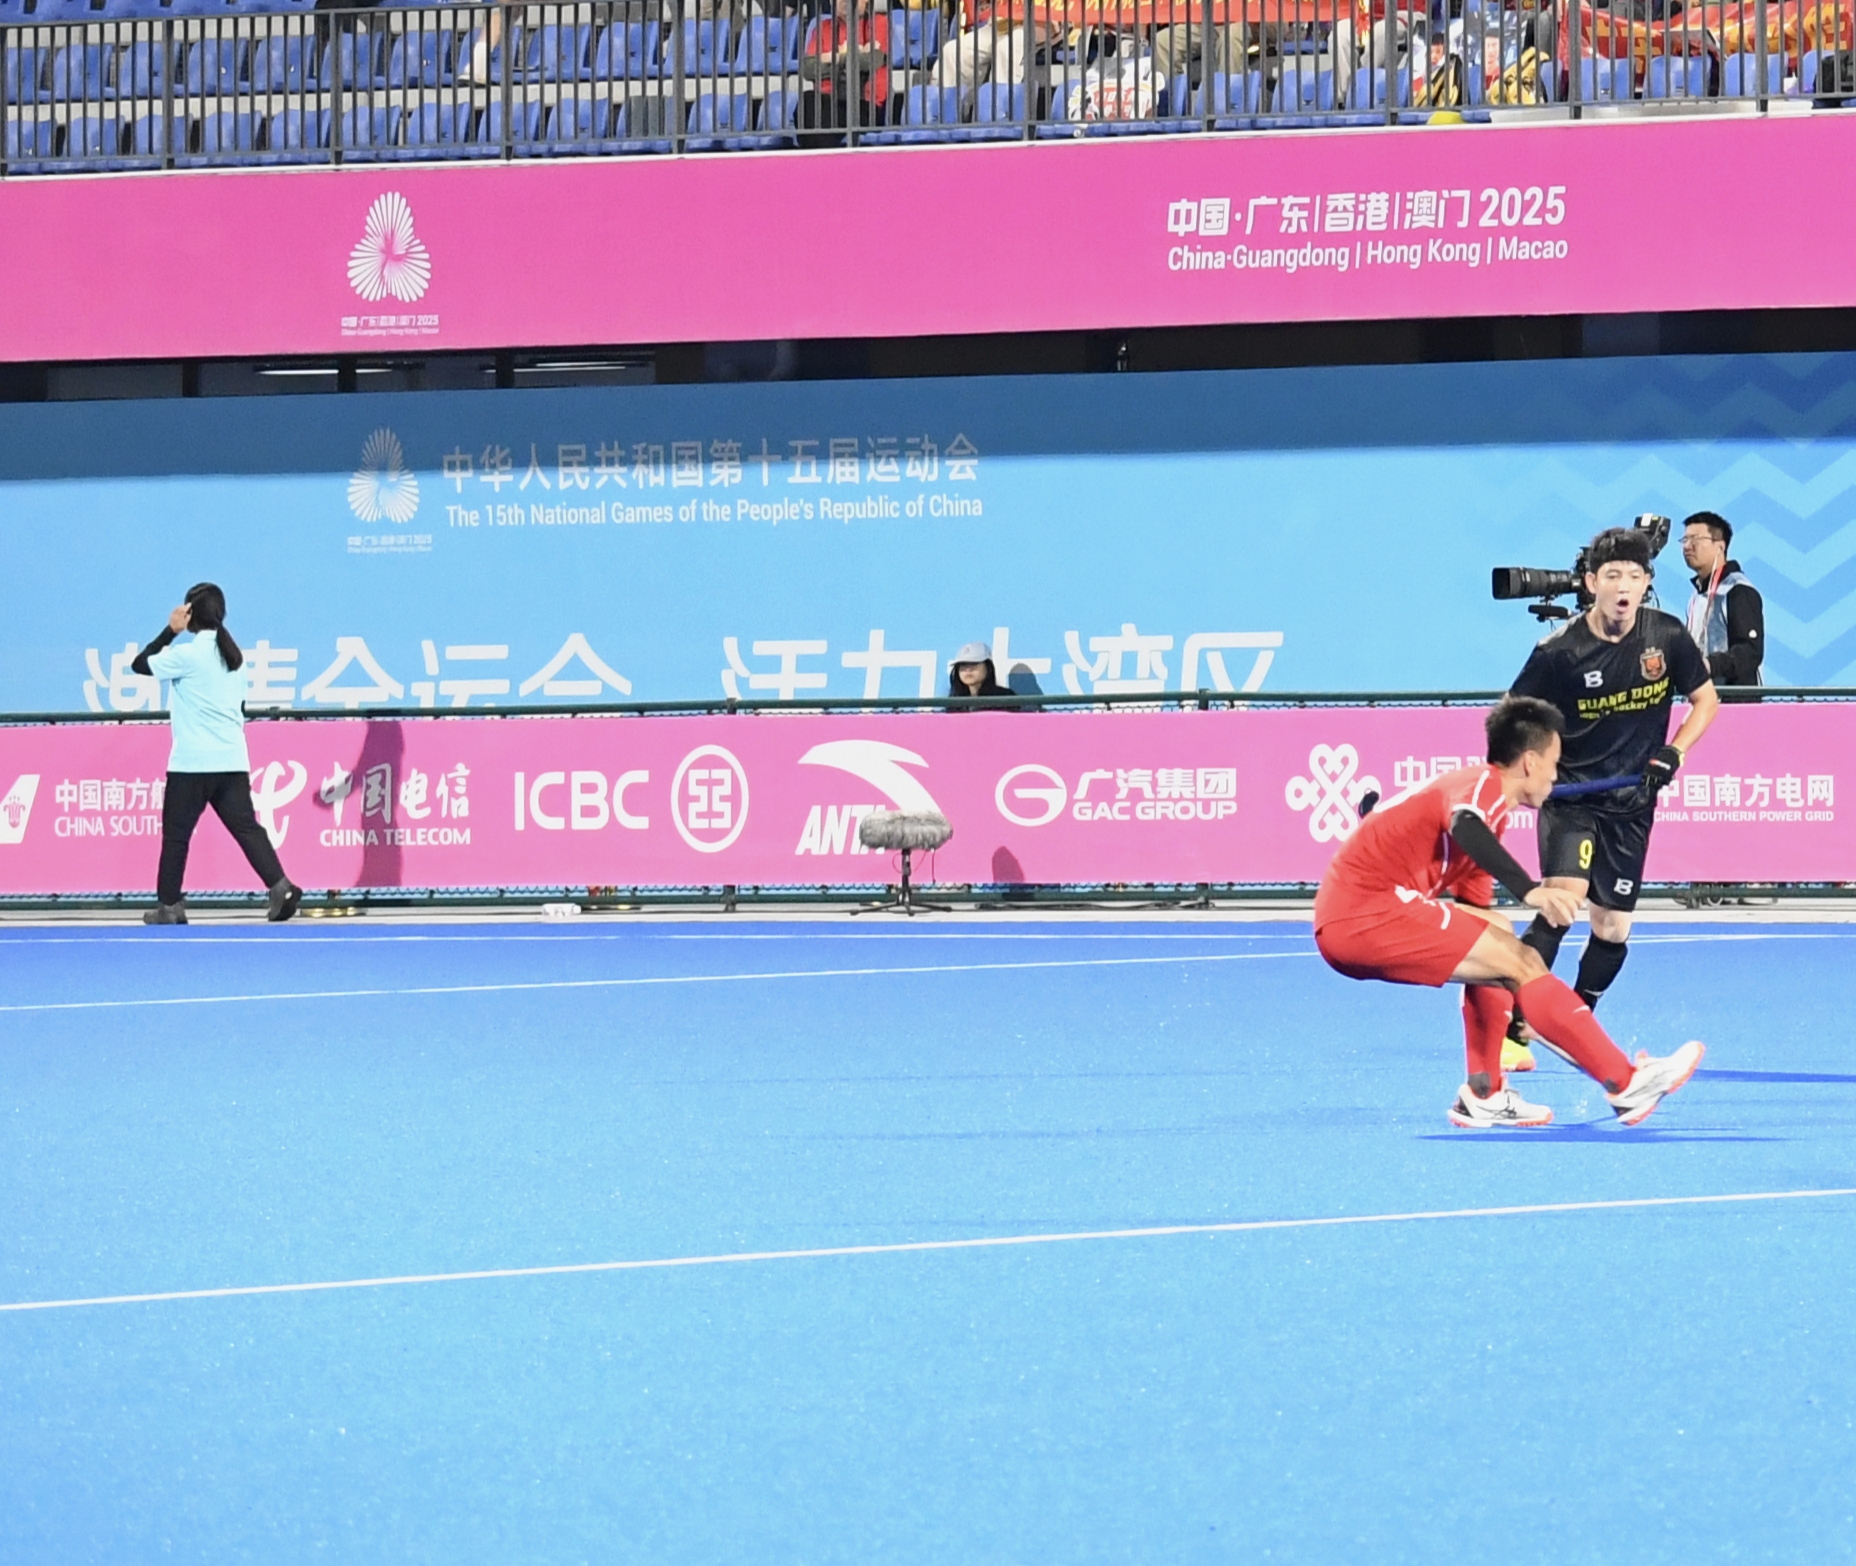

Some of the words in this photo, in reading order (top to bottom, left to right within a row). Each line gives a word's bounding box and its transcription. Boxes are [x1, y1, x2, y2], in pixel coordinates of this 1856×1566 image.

[1479, 185, 1567, 228] 2025
[1366, 239, 1422, 269] Hong
[1427, 237, 1481, 267] Kong
[1498, 235, 1568, 260] Macao
[442, 434, 979, 493] 中华人民共和国第十五届运动会
[445, 504, 479, 528] The
[485, 503, 526, 528] 15th
[530, 501, 607, 525] National
[611, 500, 674, 525] Games
[678, 498, 698, 523] of
[701, 498, 733, 522] the
[737, 497, 814, 525] People's
[818, 495, 900, 524] Republic
[904, 495, 926, 519] of
[929, 494, 983, 517] China
[1578, 691, 1627, 711] GUANG
[319, 762, 472, 827] 中国电信
[514, 770, 650, 830] ICBC
[1072, 767, 1237, 800] 广汽集团
[1655, 773, 1835, 808] 中国南方电网
[54, 816, 105, 838] CHINA
[1072, 801, 1131, 821] GAC
[1135, 800, 1238, 820] GROUP
[1653, 811, 1690, 822] CHINA
[1693, 811, 1756, 822] SOUTHERN
[1759, 811, 1802, 822] POWER
[1805, 811, 1835, 822] GRID
[320, 829, 378, 847] CHINA
[383, 828, 472, 846] TELECOM
[1578, 838, 1594, 870] 9
